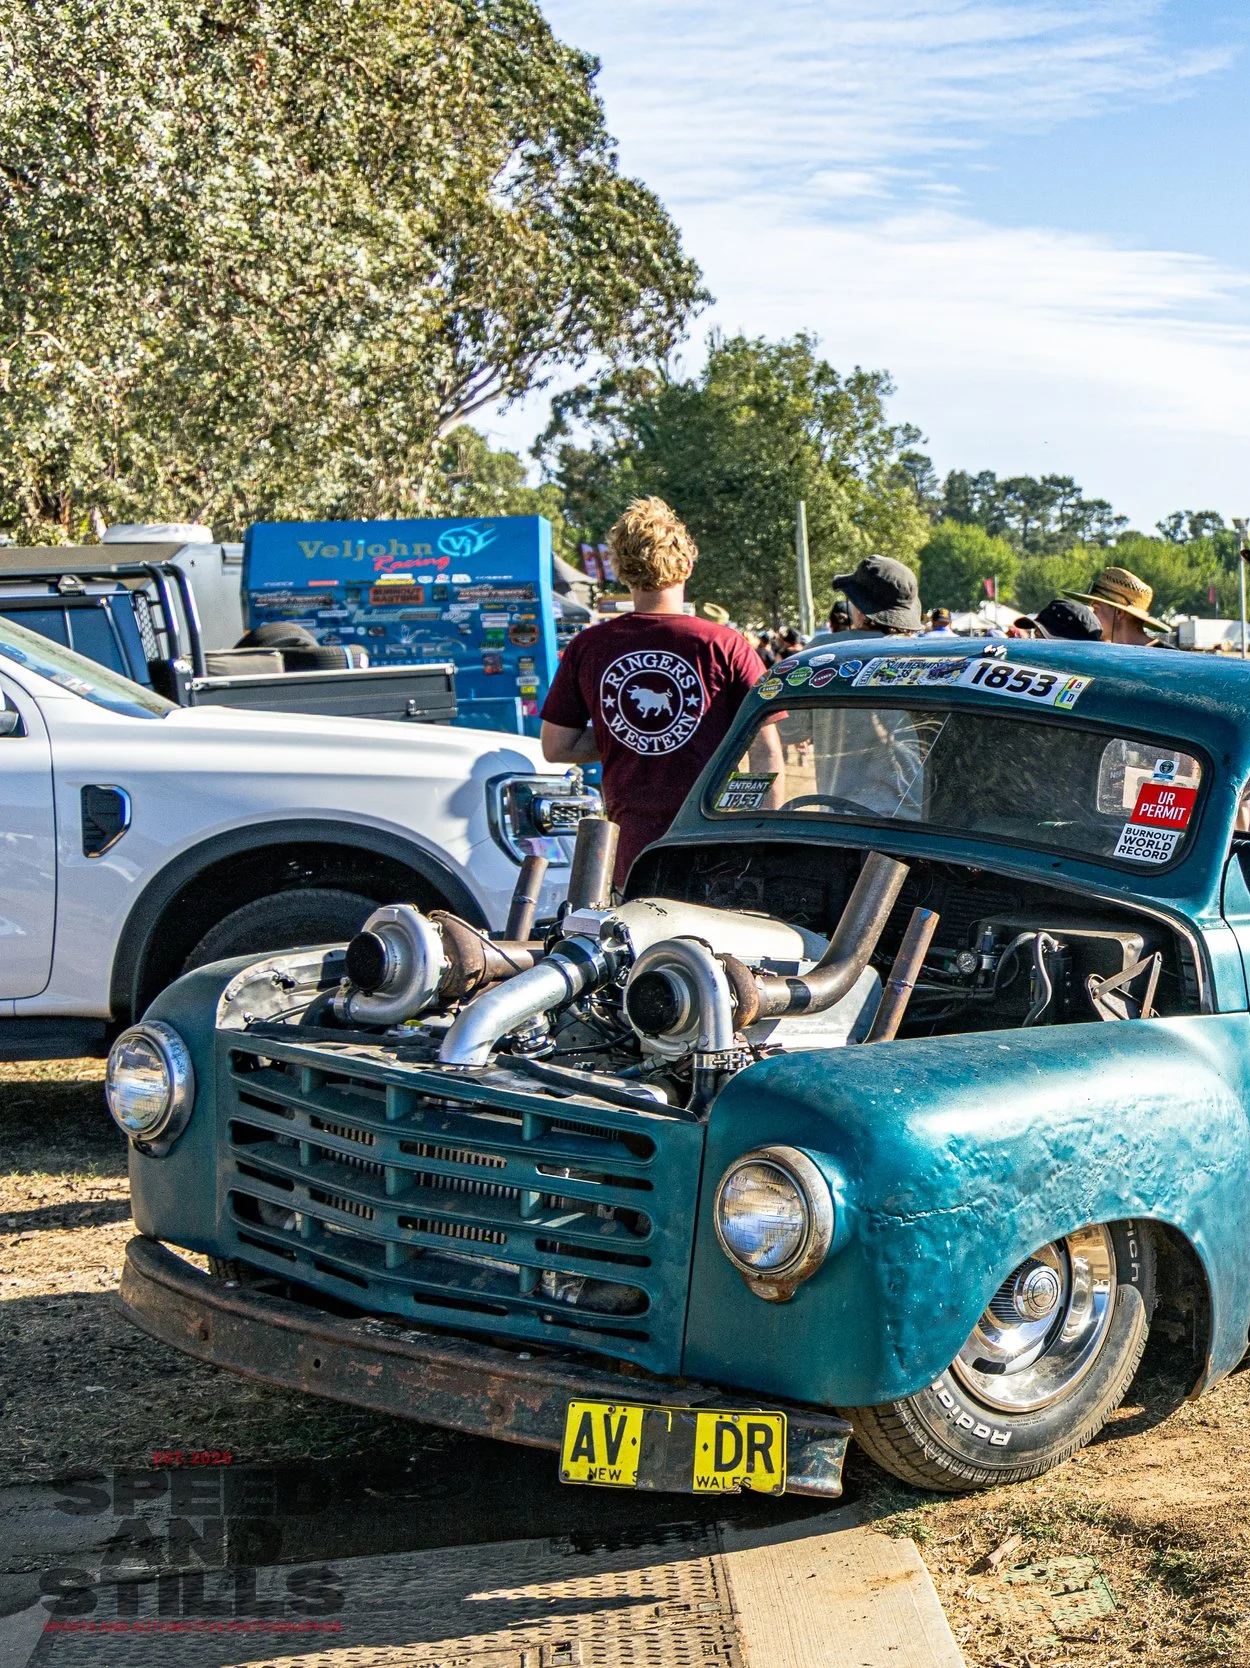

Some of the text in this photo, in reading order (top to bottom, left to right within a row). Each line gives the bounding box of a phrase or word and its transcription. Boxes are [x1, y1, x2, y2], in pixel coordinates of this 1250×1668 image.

[298, 539, 432, 561] Veljohn
[373, 555, 450, 573] Racing
[605, 654, 696, 689] RINGERS
[971, 661, 1058, 698] 1853
[610, 712, 696, 752] WESTERN
[728, 781, 770, 790] ENTRANT
[1157, 791, 1176, 806] UR
[1139, 803, 1186, 821] PERMIT
[1123, 835, 1172, 851] WORLD
[1125, 827, 1176, 842] BURNOUT
[1118, 845, 1168, 861] RECORD
[930, 1380, 1012, 1447] Radial
[570, 1411, 775, 1474] AV DR
[588, 1467, 622, 1482] NEW
